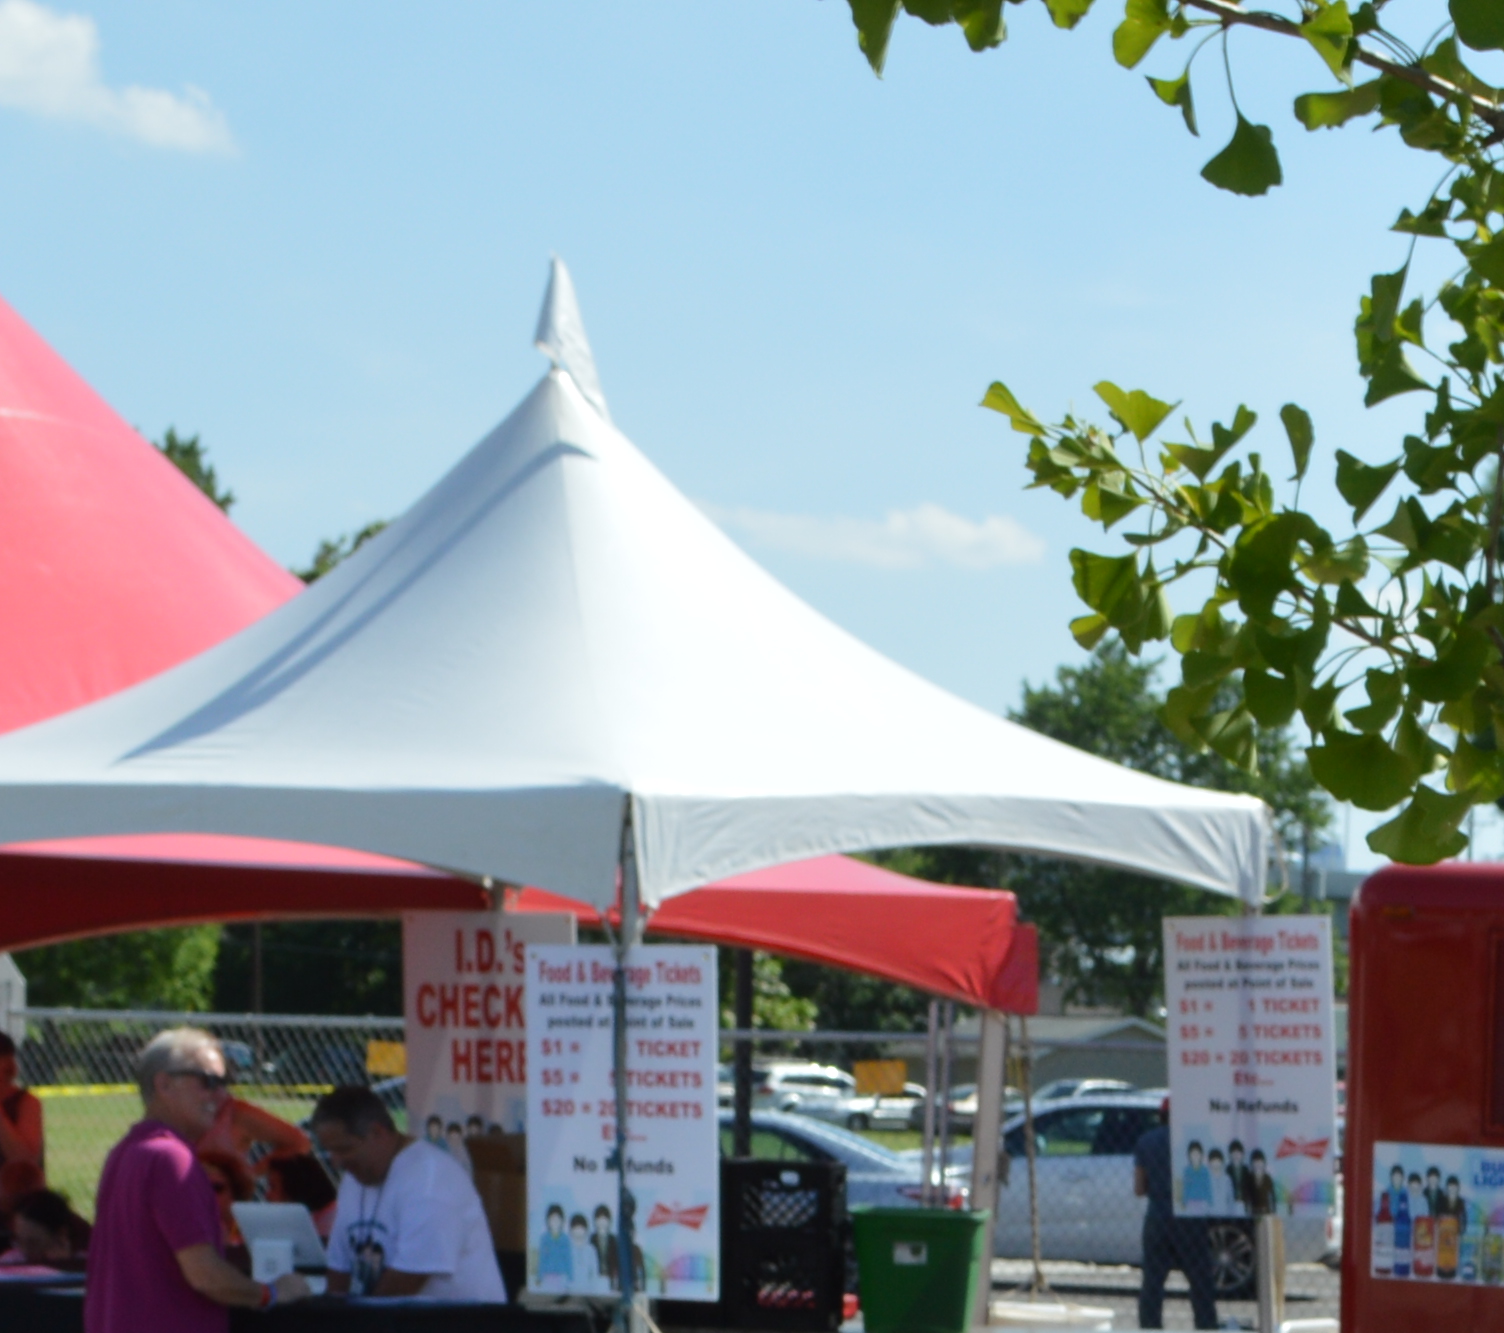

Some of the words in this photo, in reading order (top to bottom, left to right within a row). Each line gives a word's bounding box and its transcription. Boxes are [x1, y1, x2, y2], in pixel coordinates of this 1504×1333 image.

[1176, 931, 1204, 951] Food
[1209, 932, 1217, 951] &
[1221, 931, 1275, 956] Beverage
[1278, 930, 1320, 951] Tickets
[538, 960, 572, 984] Food
[578, 961, 586, 983] &
[655, 961, 703, 985] Tickets
[1263, 997, 1320, 1012] TICKET
[1254, 1024, 1322, 1039] TICKETS
[636, 1039, 703, 1058] TICKET
[1254, 1050, 1324, 1066] TICKETS
[626, 1070, 703, 1089] TICKETS
[542, 1098, 575, 1116] $20
[627, 1101, 703, 1119] TICKETS
[1210, 1099, 1230, 1113] No
[1236, 1099, 1299, 1113] Refunds
[573, 1156, 596, 1171] No
